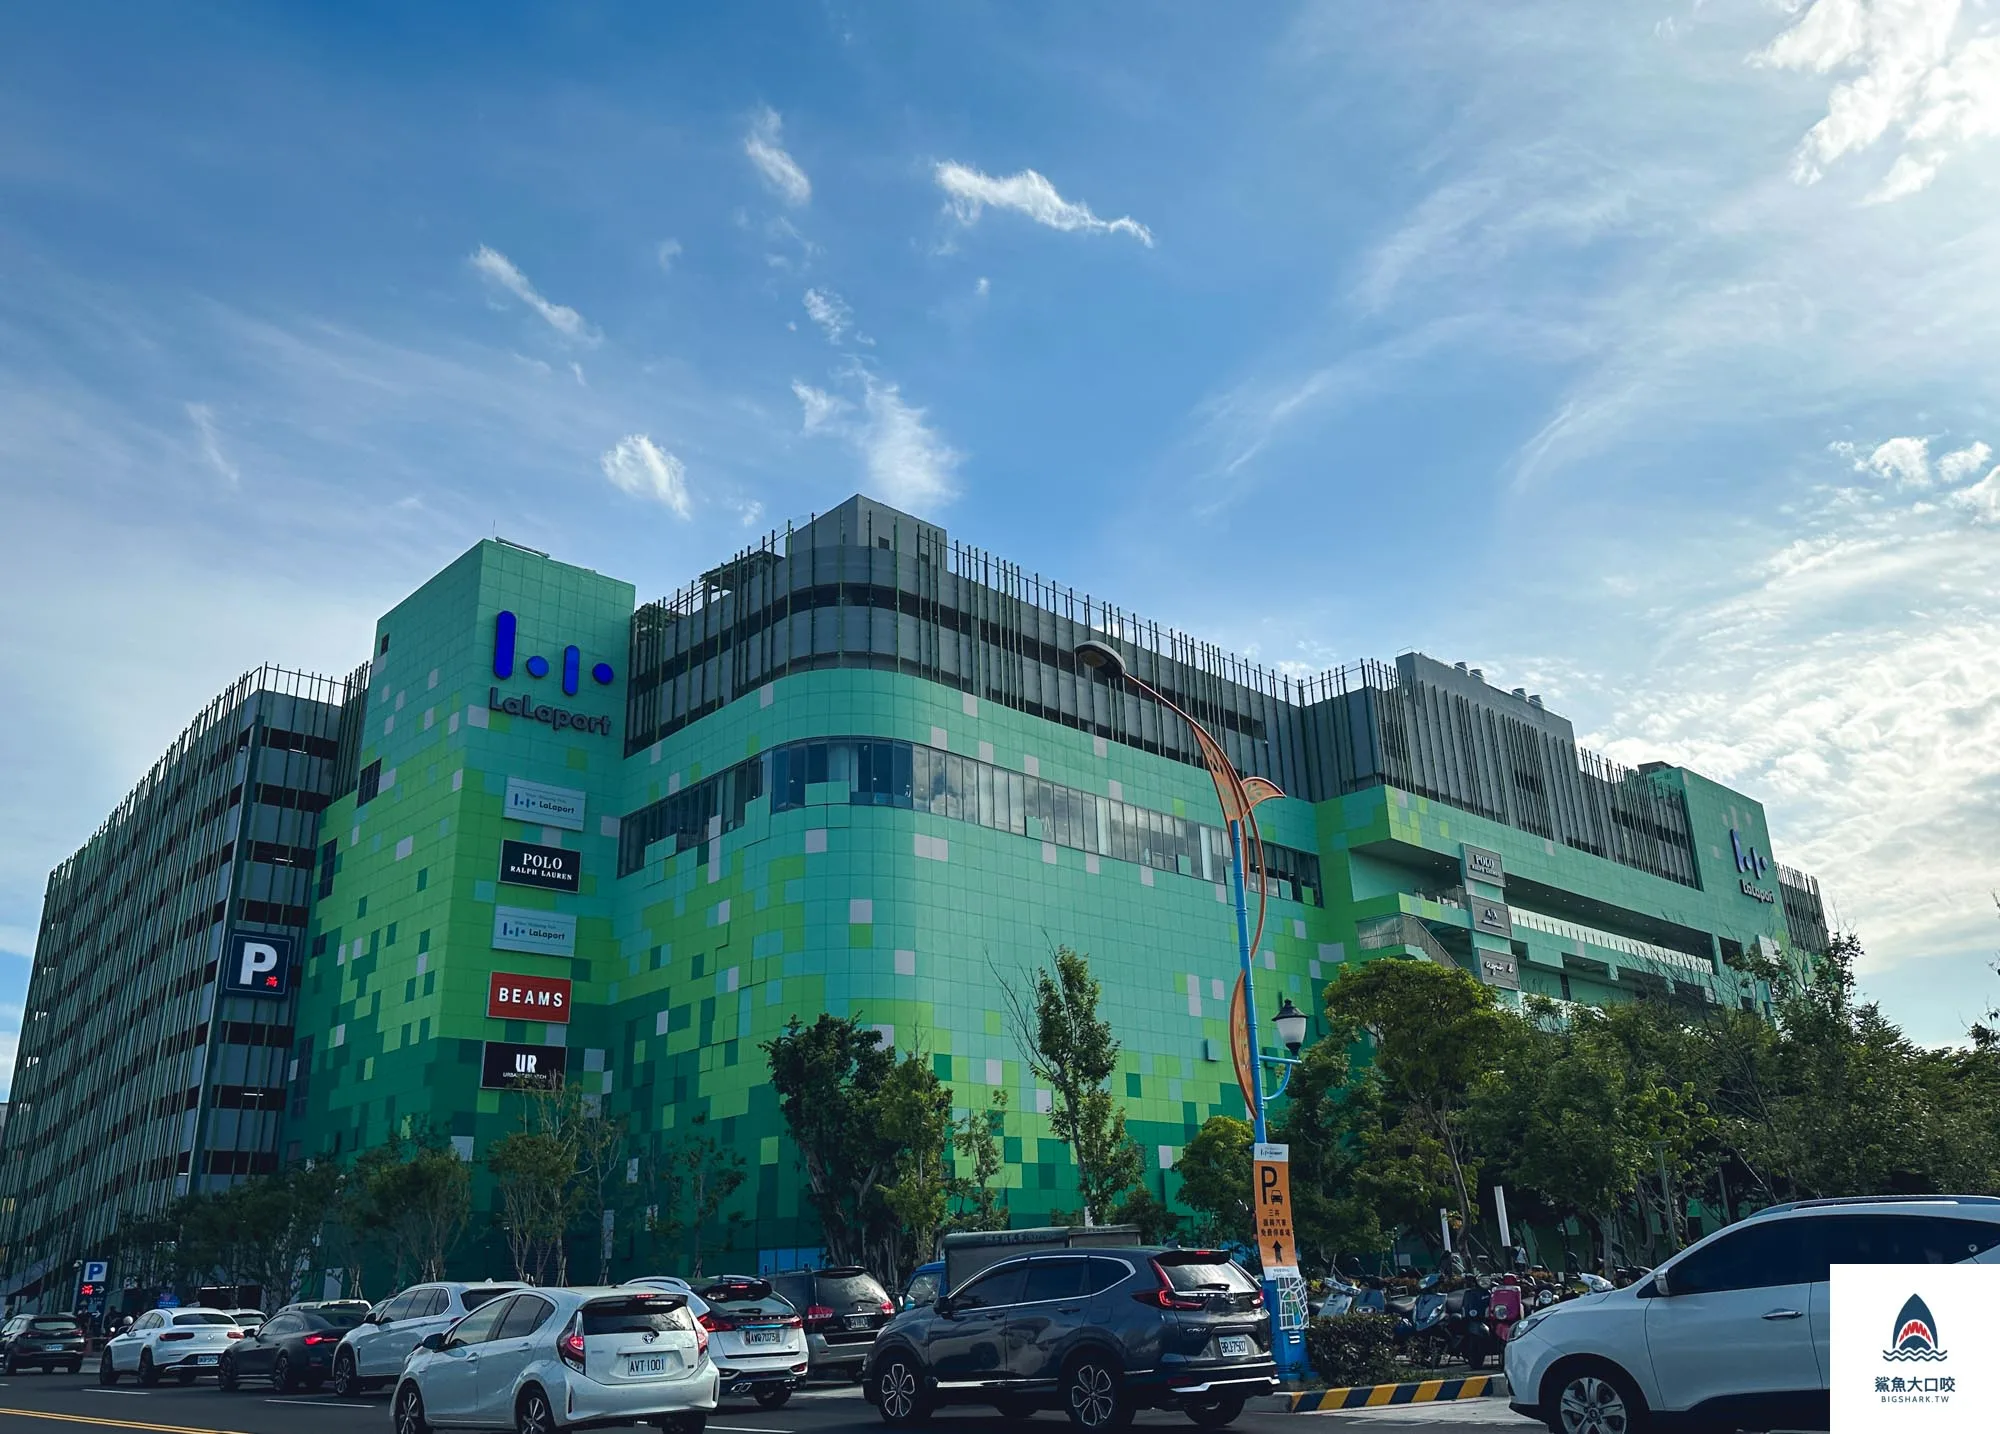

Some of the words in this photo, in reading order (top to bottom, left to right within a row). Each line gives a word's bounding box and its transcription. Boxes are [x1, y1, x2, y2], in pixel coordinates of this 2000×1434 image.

[489, 687, 612, 736] LaLaport
[539, 801, 575, 814] LaLaport
[523, 853, 563, 870] POLO
[1474, 854, 1495, 869] POLO
[510, 865, 537, 876] RALPH
[541, 870, 573, 881] LAUREN
[529, 928, 566, 940] LaLaport
[239, 942, 278, 985] P
[498, 987, 563, 1008] BEAMS
[515, 1054, 538, 1073] UR
[1260, 1165, 1278, 1205] P
[88, 1263, 104, 1280] P
